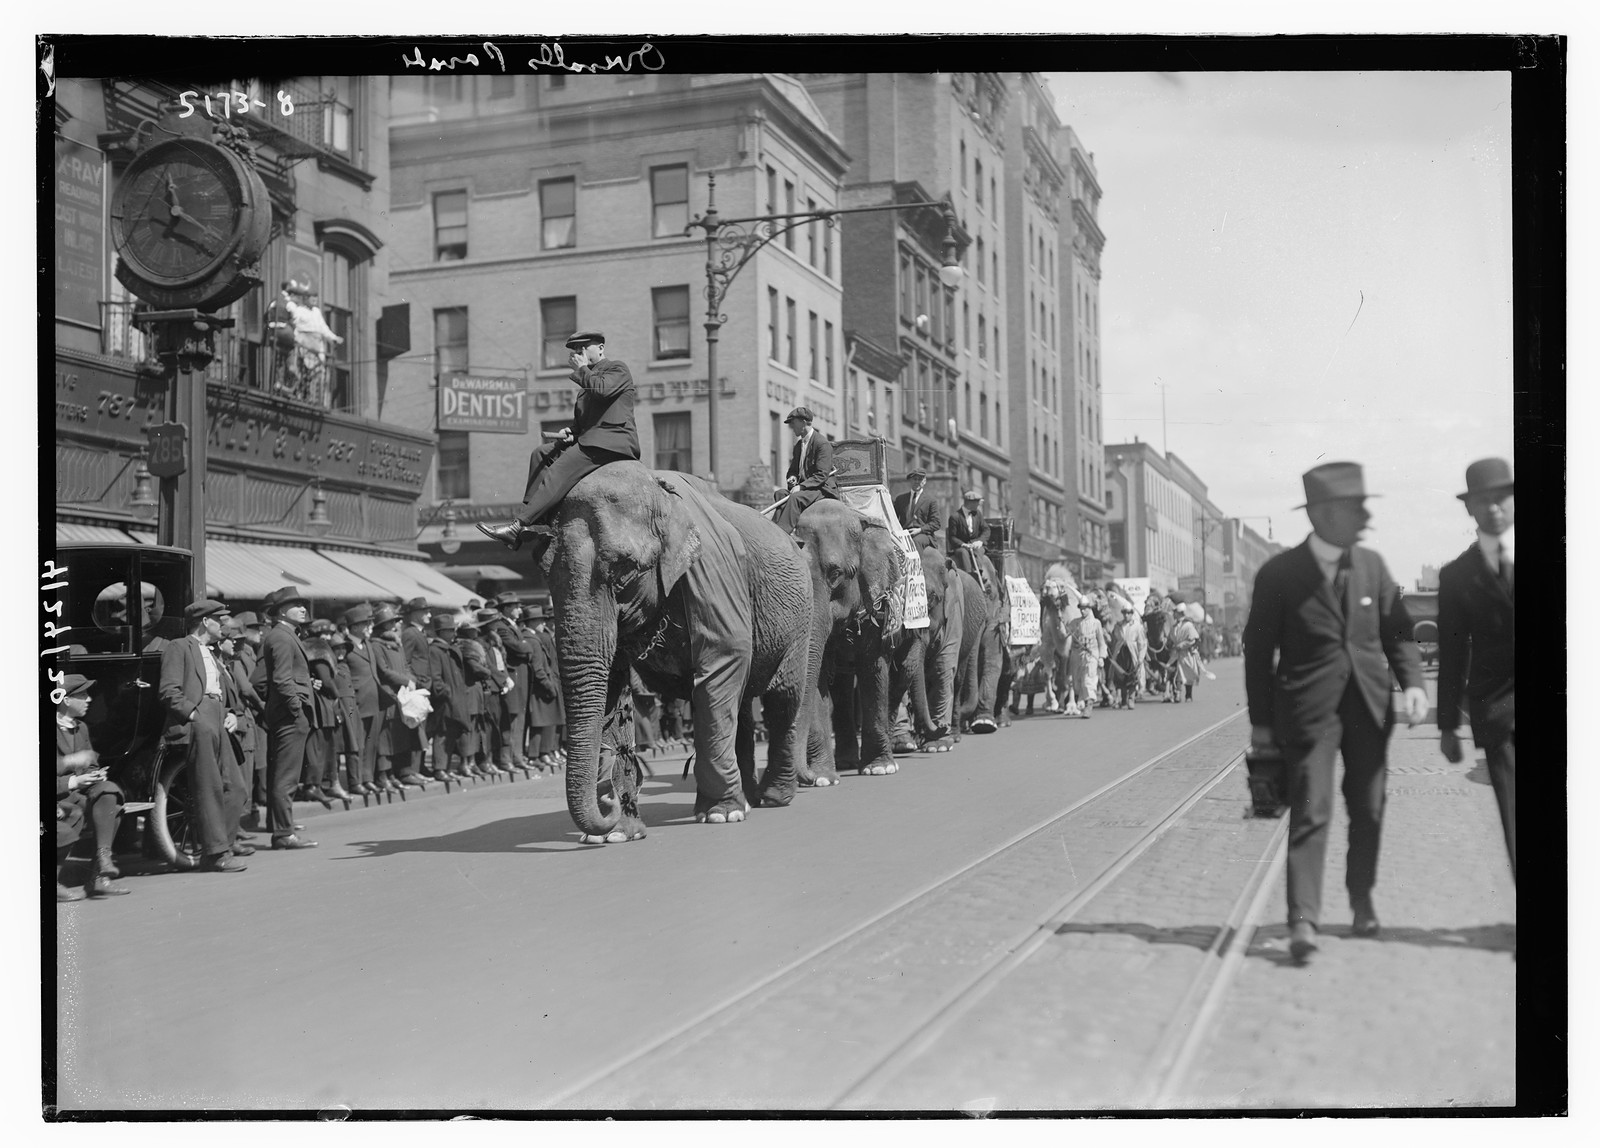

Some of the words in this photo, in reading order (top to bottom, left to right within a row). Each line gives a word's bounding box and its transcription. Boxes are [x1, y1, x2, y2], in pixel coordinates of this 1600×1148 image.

[57, 154, 102, 187] X-RAY
[443, 387, 526, 419] DENTIST
[97, 390, 136, 417] 787
[327, 438, 357, 462] 787
[151, 436, 181, 464] 785
